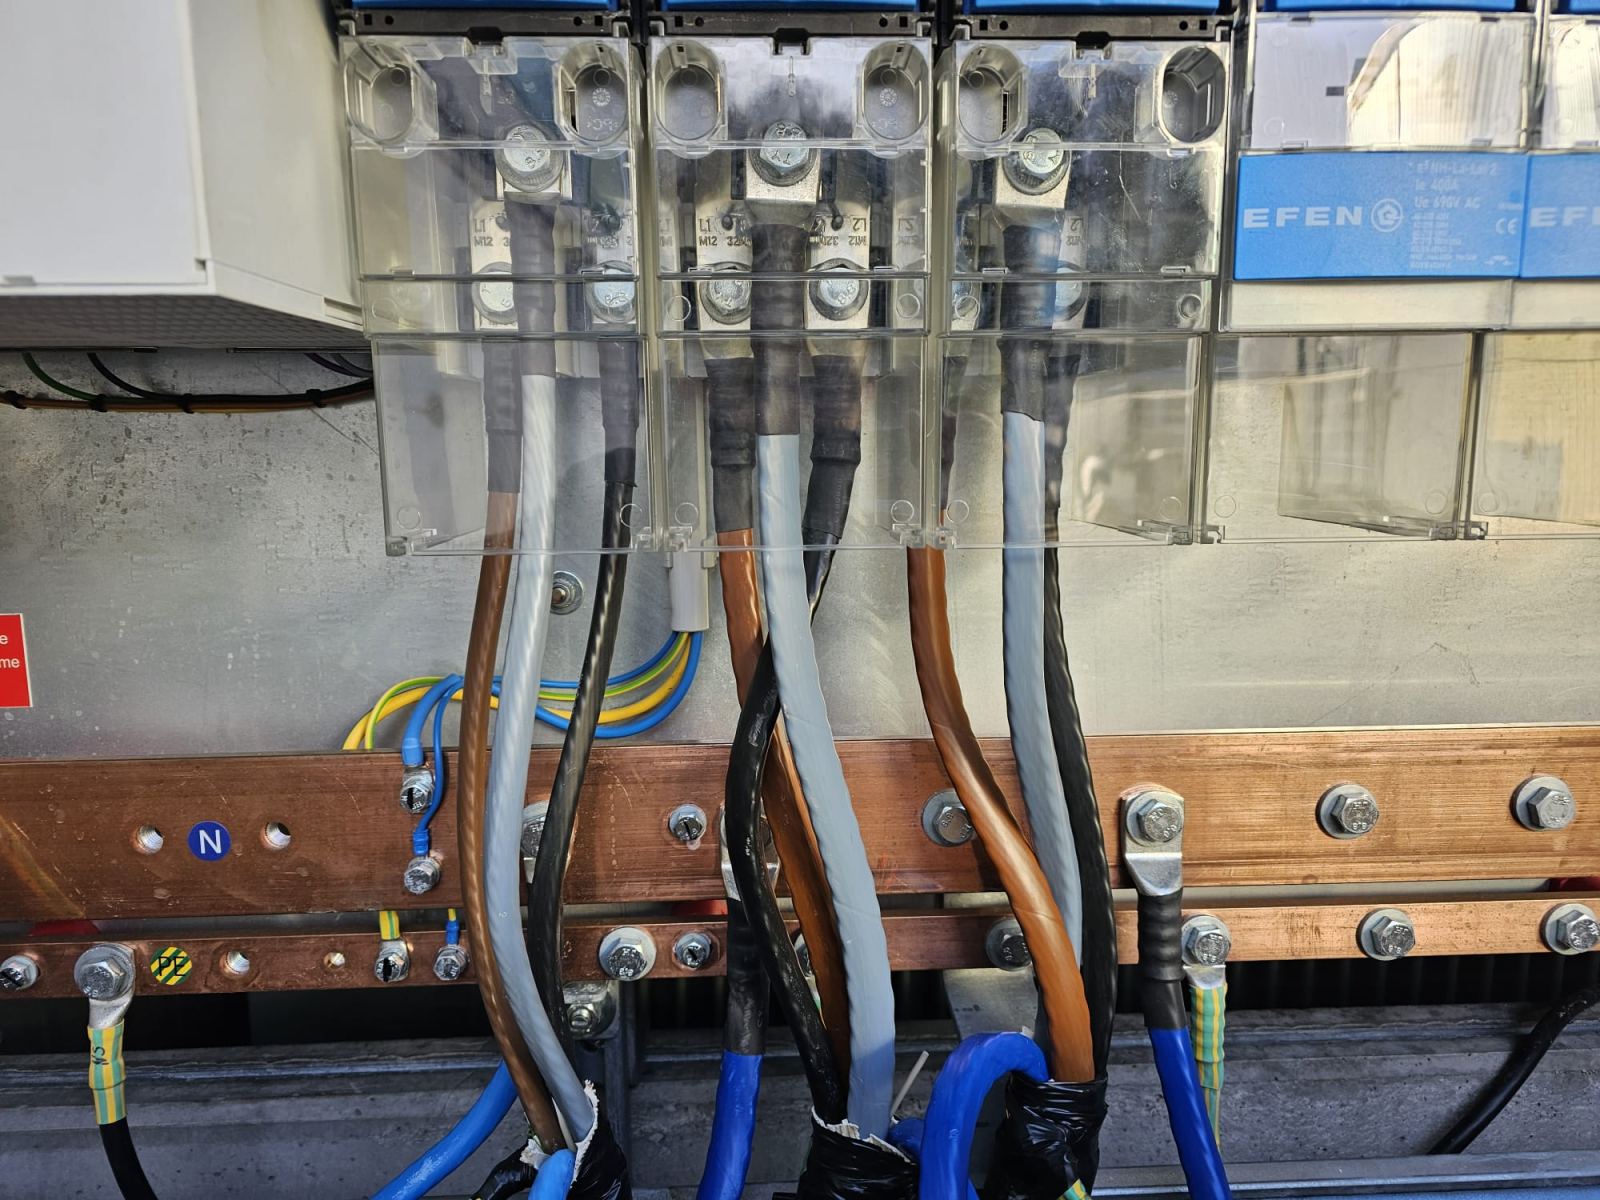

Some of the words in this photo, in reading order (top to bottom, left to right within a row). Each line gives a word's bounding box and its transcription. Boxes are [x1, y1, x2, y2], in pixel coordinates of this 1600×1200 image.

[1243, 206, 1363, 229] EFEN
[473, 218, 486, 232] L1
[699, 218, 711, 232] L1
[474, 236, 494, 247] M12
[699, 236, 718, 247] M12
[198, 829, 222, 854] N
[158, 956, 186, 977] PE
